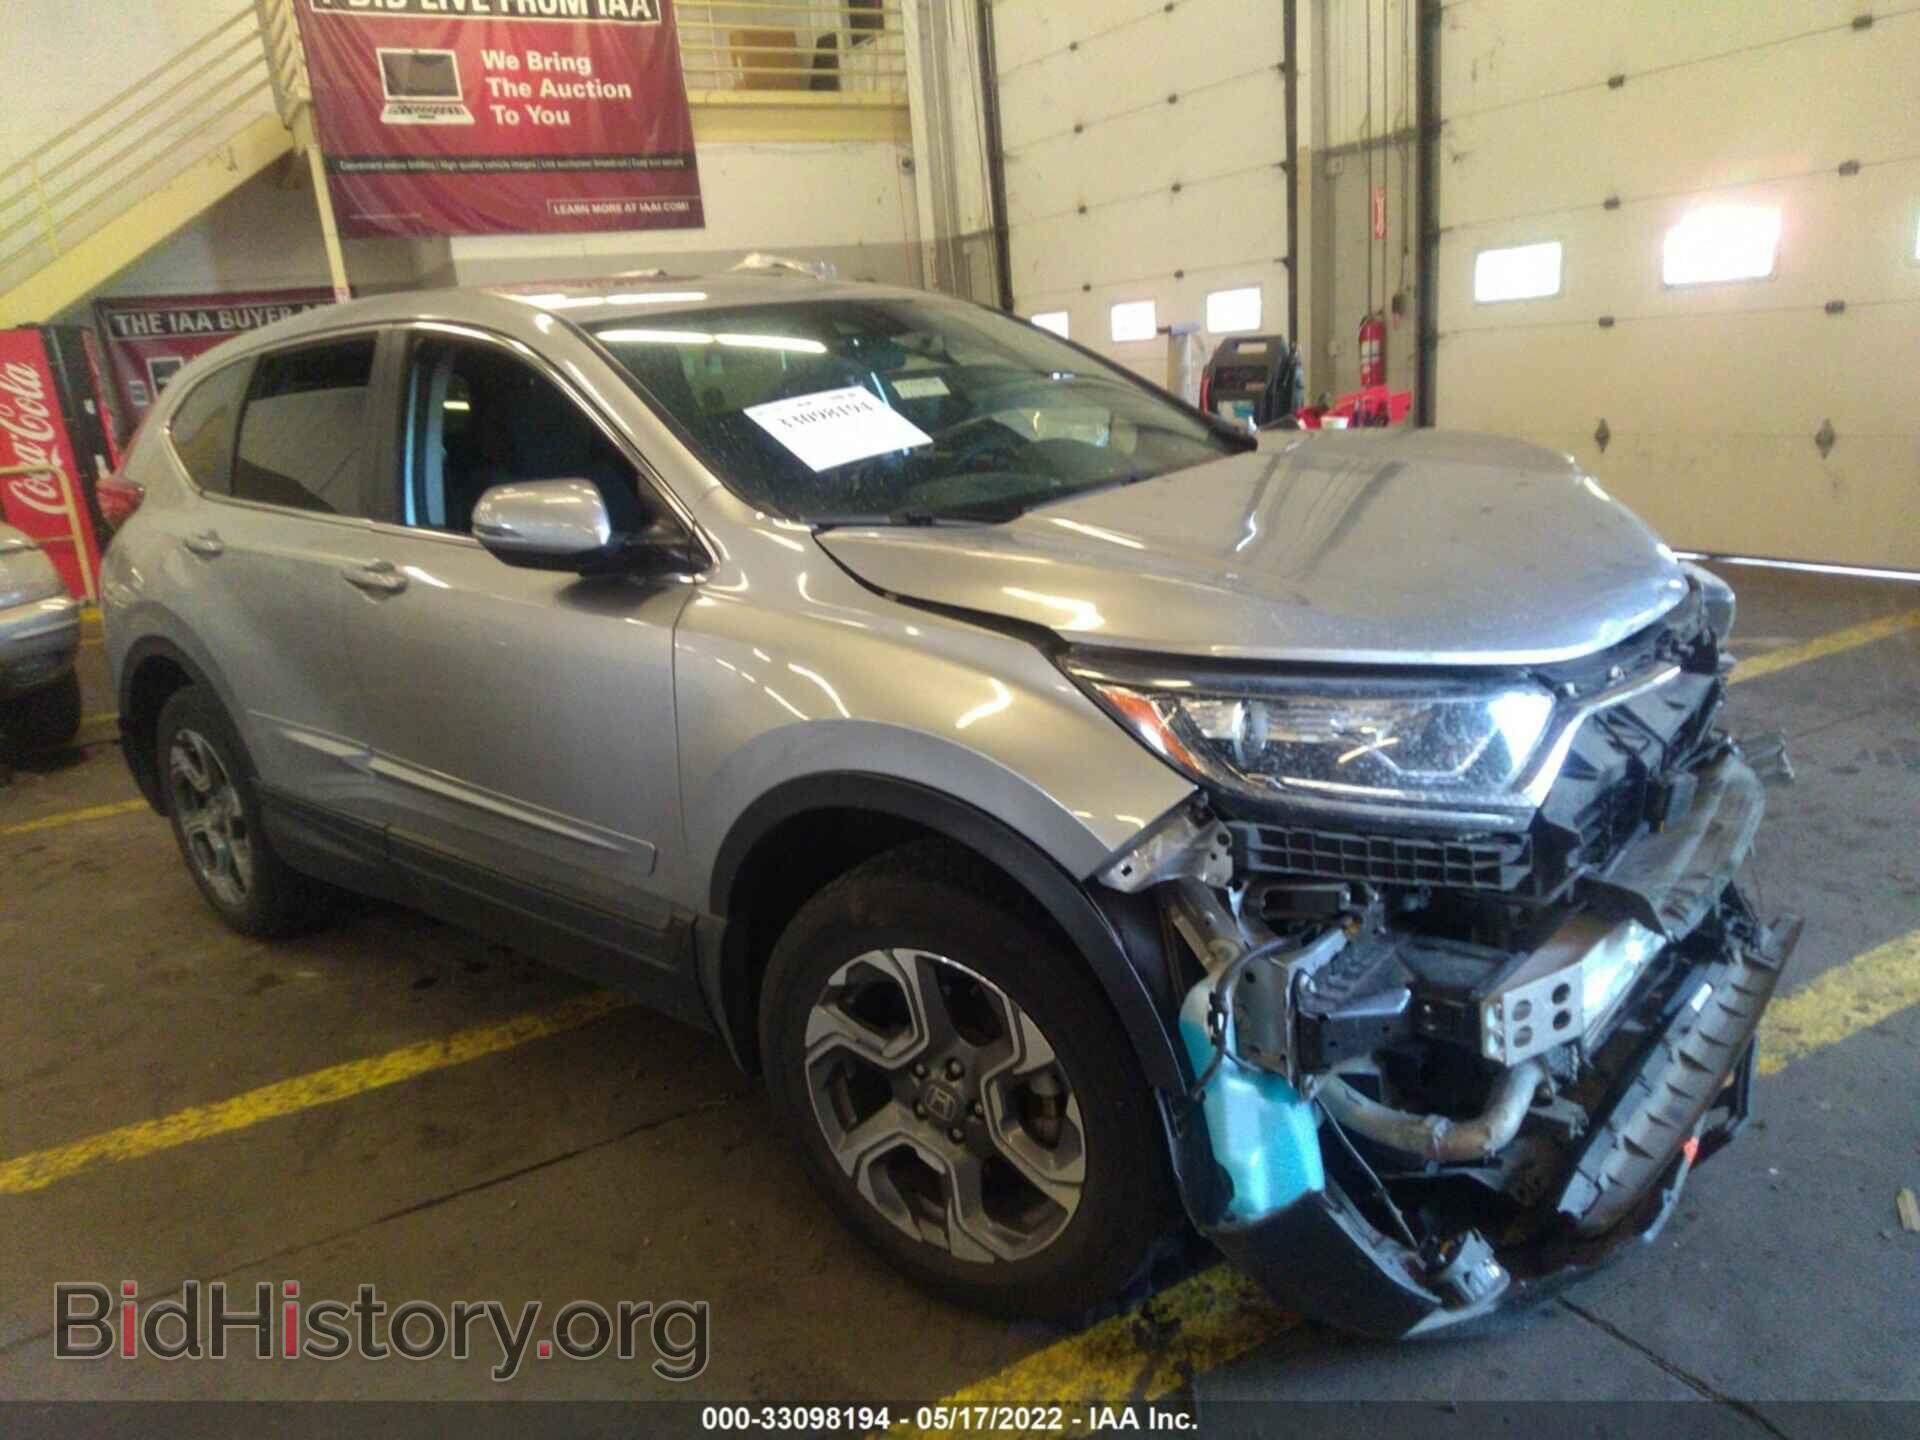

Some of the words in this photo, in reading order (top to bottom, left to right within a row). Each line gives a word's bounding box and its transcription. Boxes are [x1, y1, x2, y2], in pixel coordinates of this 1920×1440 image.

[481, 49, 520, 71] We
[526, 50, 592, 76] Bring
[485, 77, 532, 98] The
[539, 77, 632, 98] Auction
[490, 104, 520, 126] To
[524, 104, 571, 126] You
[553, 202, 591, 216] LEARN
[591, 202, 622, 214] MORE
[624, 201, 637, 213] AT
[114, 313, 163, 335] THE
[168, 311, 215, 332] IAA
